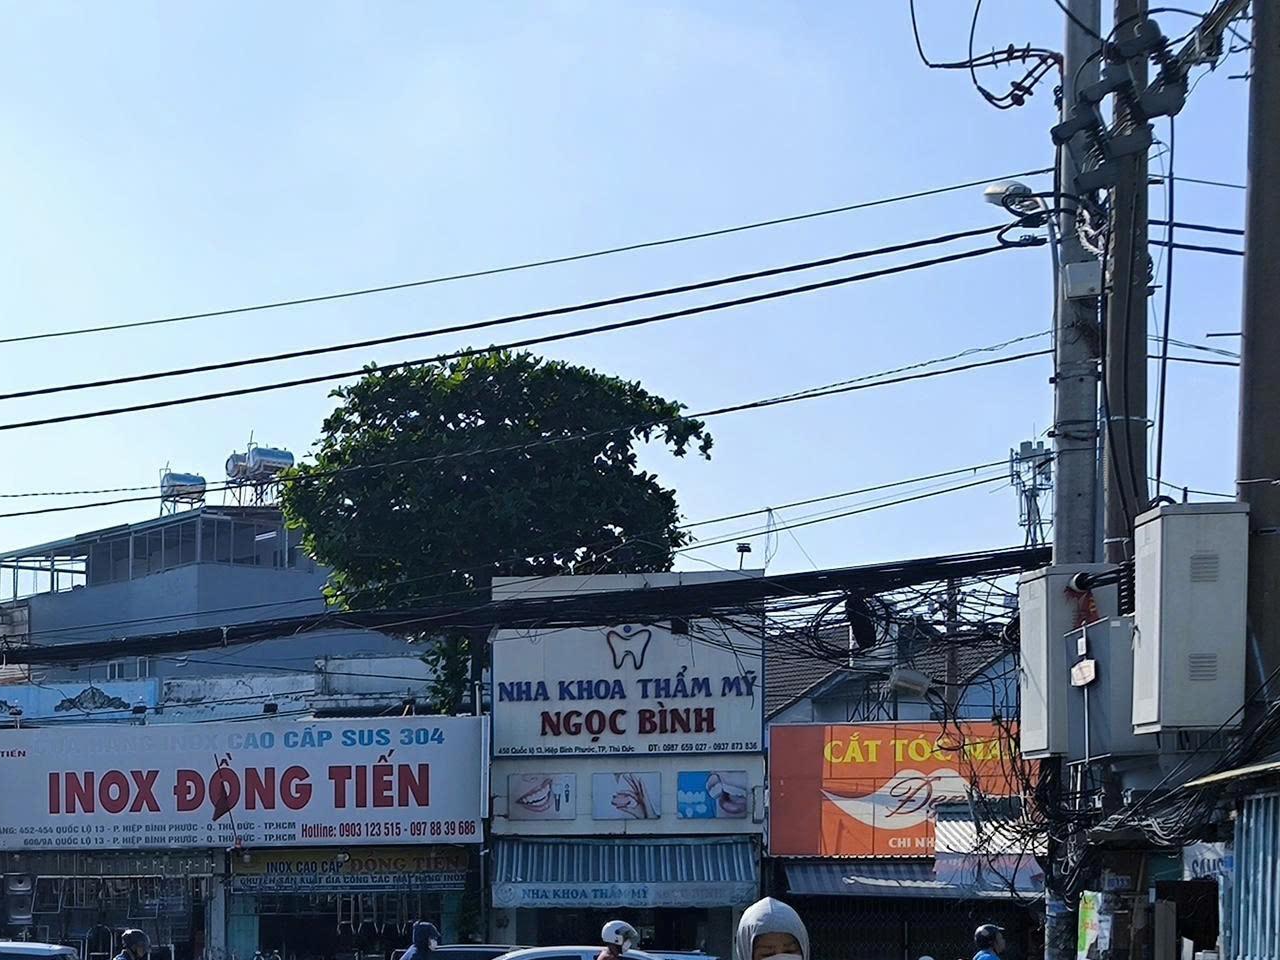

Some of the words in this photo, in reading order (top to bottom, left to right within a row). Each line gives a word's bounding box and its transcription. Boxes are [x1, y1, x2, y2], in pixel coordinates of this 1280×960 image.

[498, 681, 550, 702] NHA
[558, 679, 626, 701] KHOA
[637, 665, 713, 699] THẨM
[720, 670, 757, 698] MỸ
[540, 708, 628, 742] NGỌC
[637, 701, 716, 735] BÌNH
[227, 732, 275, 750] CAO
[283, 725, 333, 748] CẤP
[341, 728, 391, 747] SUS
[399, 728, 445, 746] 304
[824, 732, 881, 763] CẮT
[889, 734, 953, 763] TÓC
[48, 769, 160, 815] INOX
[173, 752, 312, 812] ĐỒNG
[328, 749, 430, 809] TIẾN
[56, 823, 79, 834] QUỐC
[81, 824, 91, 834] LỘ
[95, 825, 105, 833] 13
[123, 823, 143, 833] HIỆP
[145, 822, 166, 832] BÌNH
[168, 821, 198, 832] PHƯỚC
[207, 823, 215, 832] Q.
[237, 820, 255, 831] ĐỨC
[264, 822, 296, 830] TP.HCM
[301, 823, 337, 838] Hotline:
[339, 822, 362, 838] 0903
[365, 822, 381, 837] 123
[383, 822, 401, 836] 515
[410, 821, 428, 836] 097
[429, 821, 442, 836] 88
[444, 821, 456, 835] 39
[458, 820, 476, 835] 686
[56, 835, 79, 846] QUỐC
[81, 837, 91, 846] LỘ
[122, 836, 142, 845] HIỆP
[145, 834, 166, 844] BÌNH
[168, 833, 198, 844] PHƯỚC
[207, 835, 215, 844] Q.
[264, 833, 296, 842] TP.HCM
[888, 837, 911, 848] CHI
[266, 861, 292, 873] INOX
[296, 861, 318, 872] CAO
[321, 858, 344, 873] CẤP
[351, 853, 406, 872] ĐỒNG
[443, 873, 465, 881] INOX
[522, 888, 549, 899] NHA
[552, 888, 587, 899] KHOA
